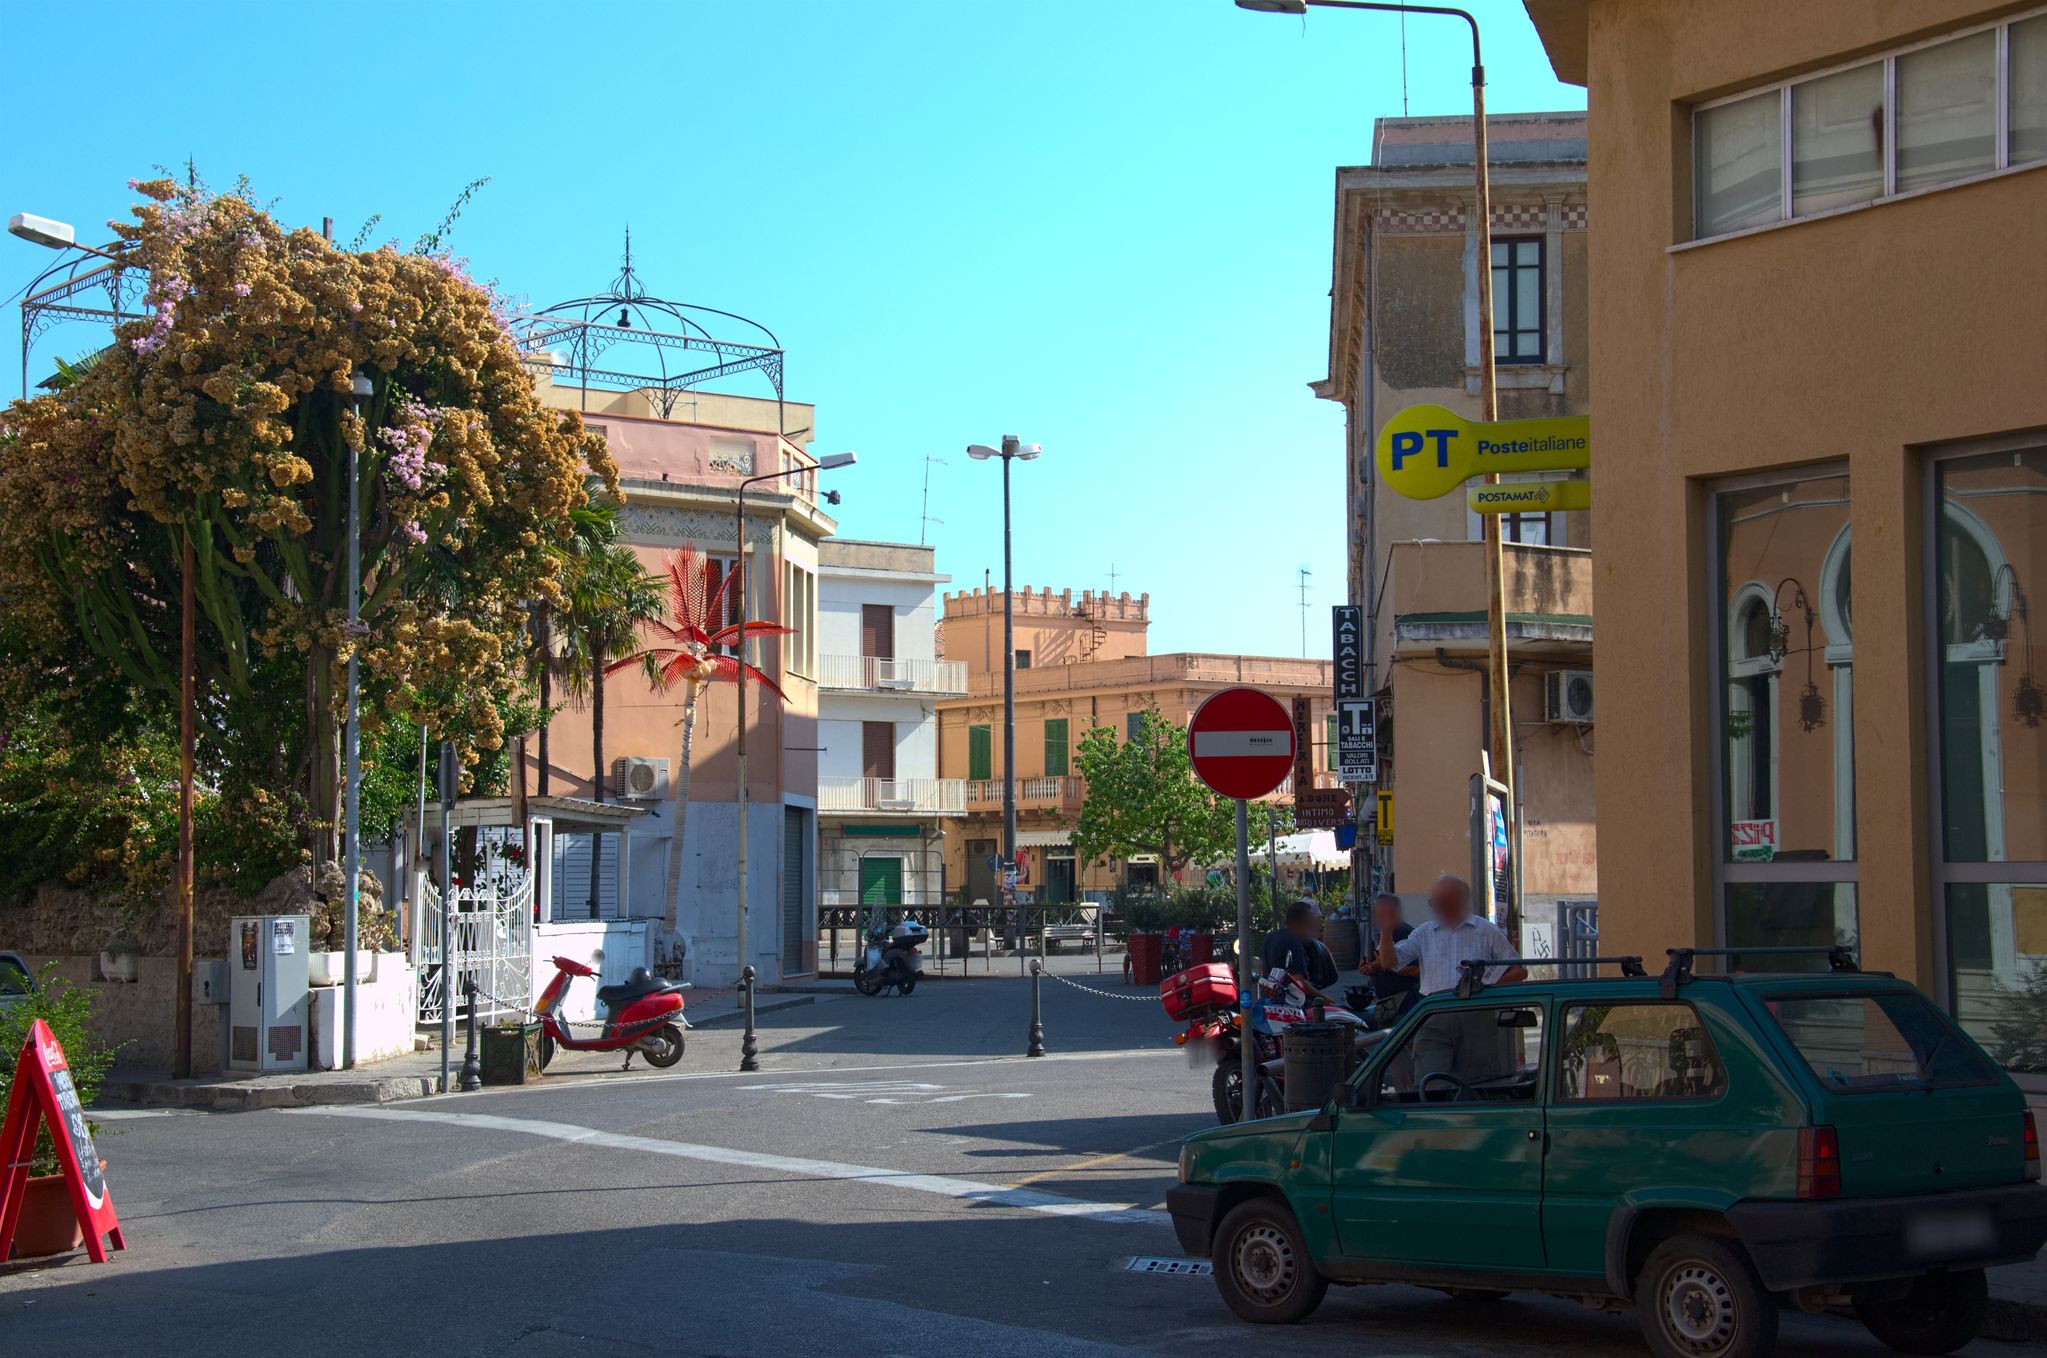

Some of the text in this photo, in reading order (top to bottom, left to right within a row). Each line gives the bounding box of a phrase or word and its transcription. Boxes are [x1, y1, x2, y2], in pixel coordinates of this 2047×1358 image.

[1391, 429, 1459, 471] PT
[1478, 435, 1586, 456] Posteitaliane
[1478, 491, 1534, 503] POSTAMAT
[1339, 609, 1356, 699] TABACCH
[1343, 703, 1369, 735] T
[1340, 741, 1373, 749] TABACCHI
[1302, 808, 1334, 817] INTIMO
[1379, 795, 1392, 828] T
